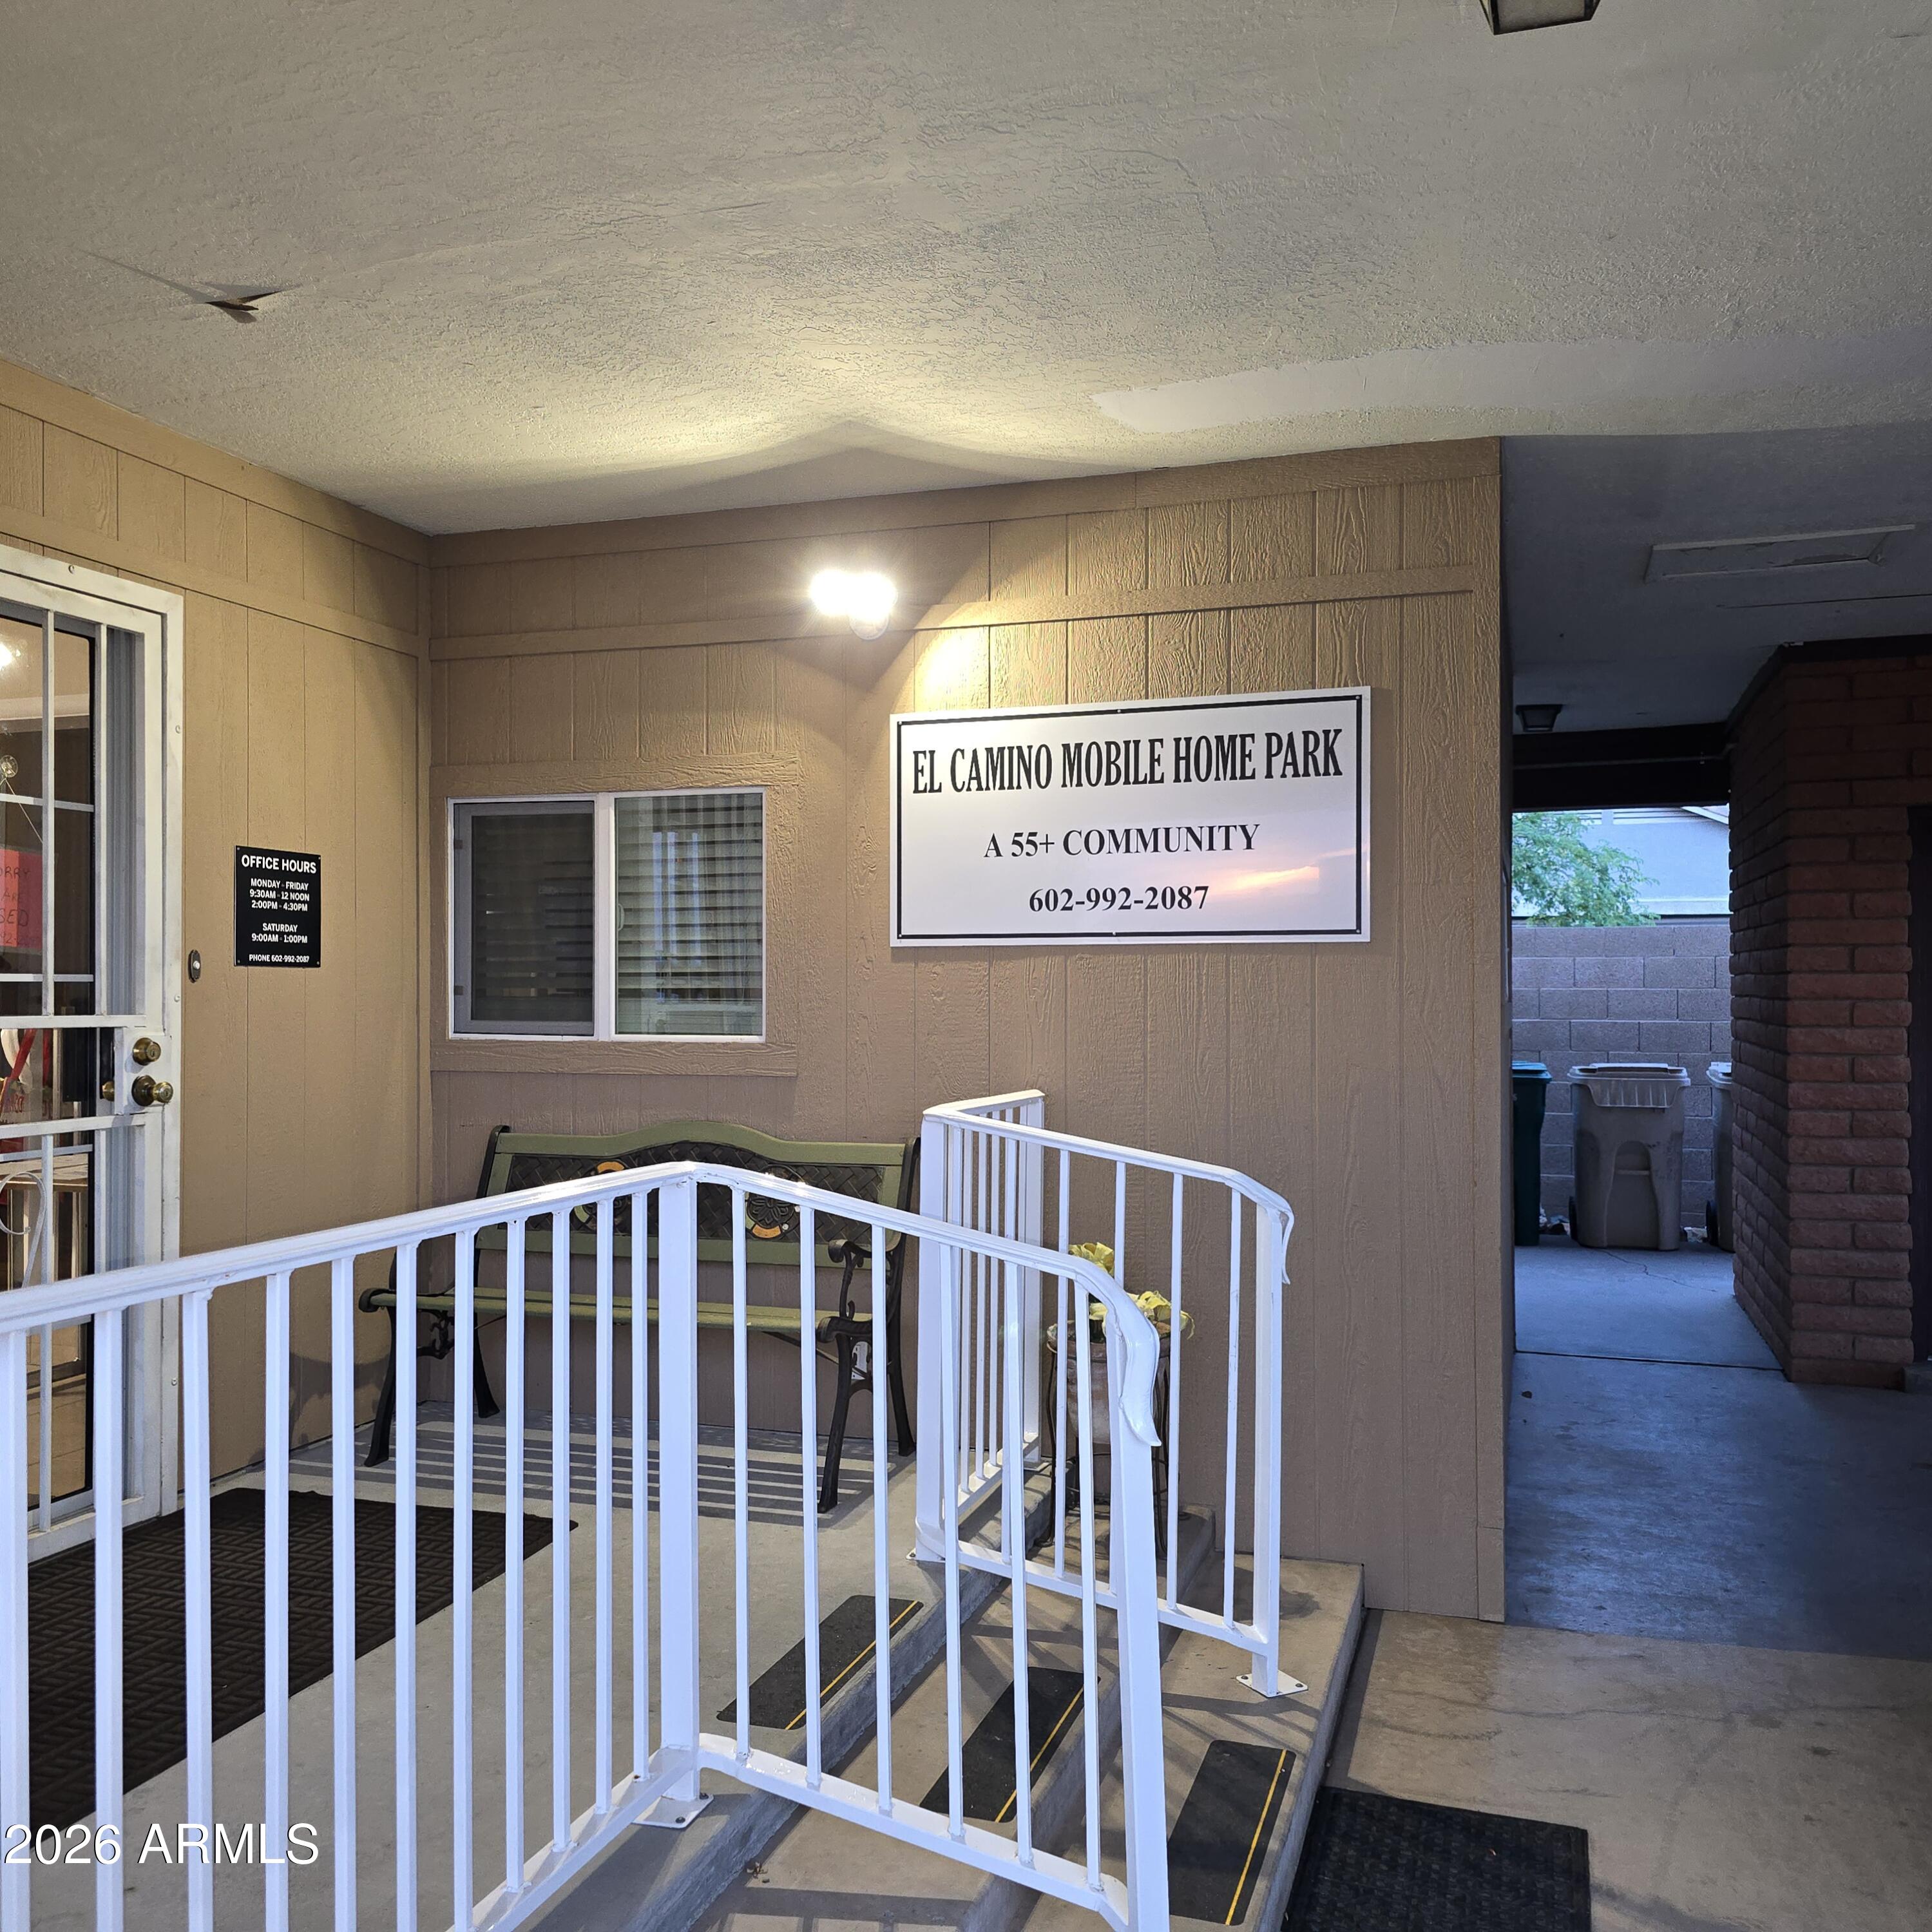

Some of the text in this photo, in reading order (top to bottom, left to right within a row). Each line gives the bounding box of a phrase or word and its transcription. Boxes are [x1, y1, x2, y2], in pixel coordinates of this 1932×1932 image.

[912, 729, 1343, 794] EL CAMINO MOBILE HOME PARK
[983, 823, 1261, 858] A 55+ COMMUNITY
[241, 854, 317, 874] OFFICE HOURS
[251, 877, 281, 888] MONDAY
[285, 881, 309, 891] FRIDAY
[249, 888, 276, 899] 9:30AM
[281, 891, 289, 900] 12
[290, 892, 310, 902] NOON
[1029, 885, 1209, 912] 602-992-2087
[251, 899, 278, 910] 2:00PM
[283, 903, 308, 912] 4:30PM
[262, 922, 298, 933] SATURDAY
[251, 933, 279, 942] 9:00AM
[283, 934, 308, 944] 1:00PM
[249, 953, 310, 963] PHONE 602-992-2087
